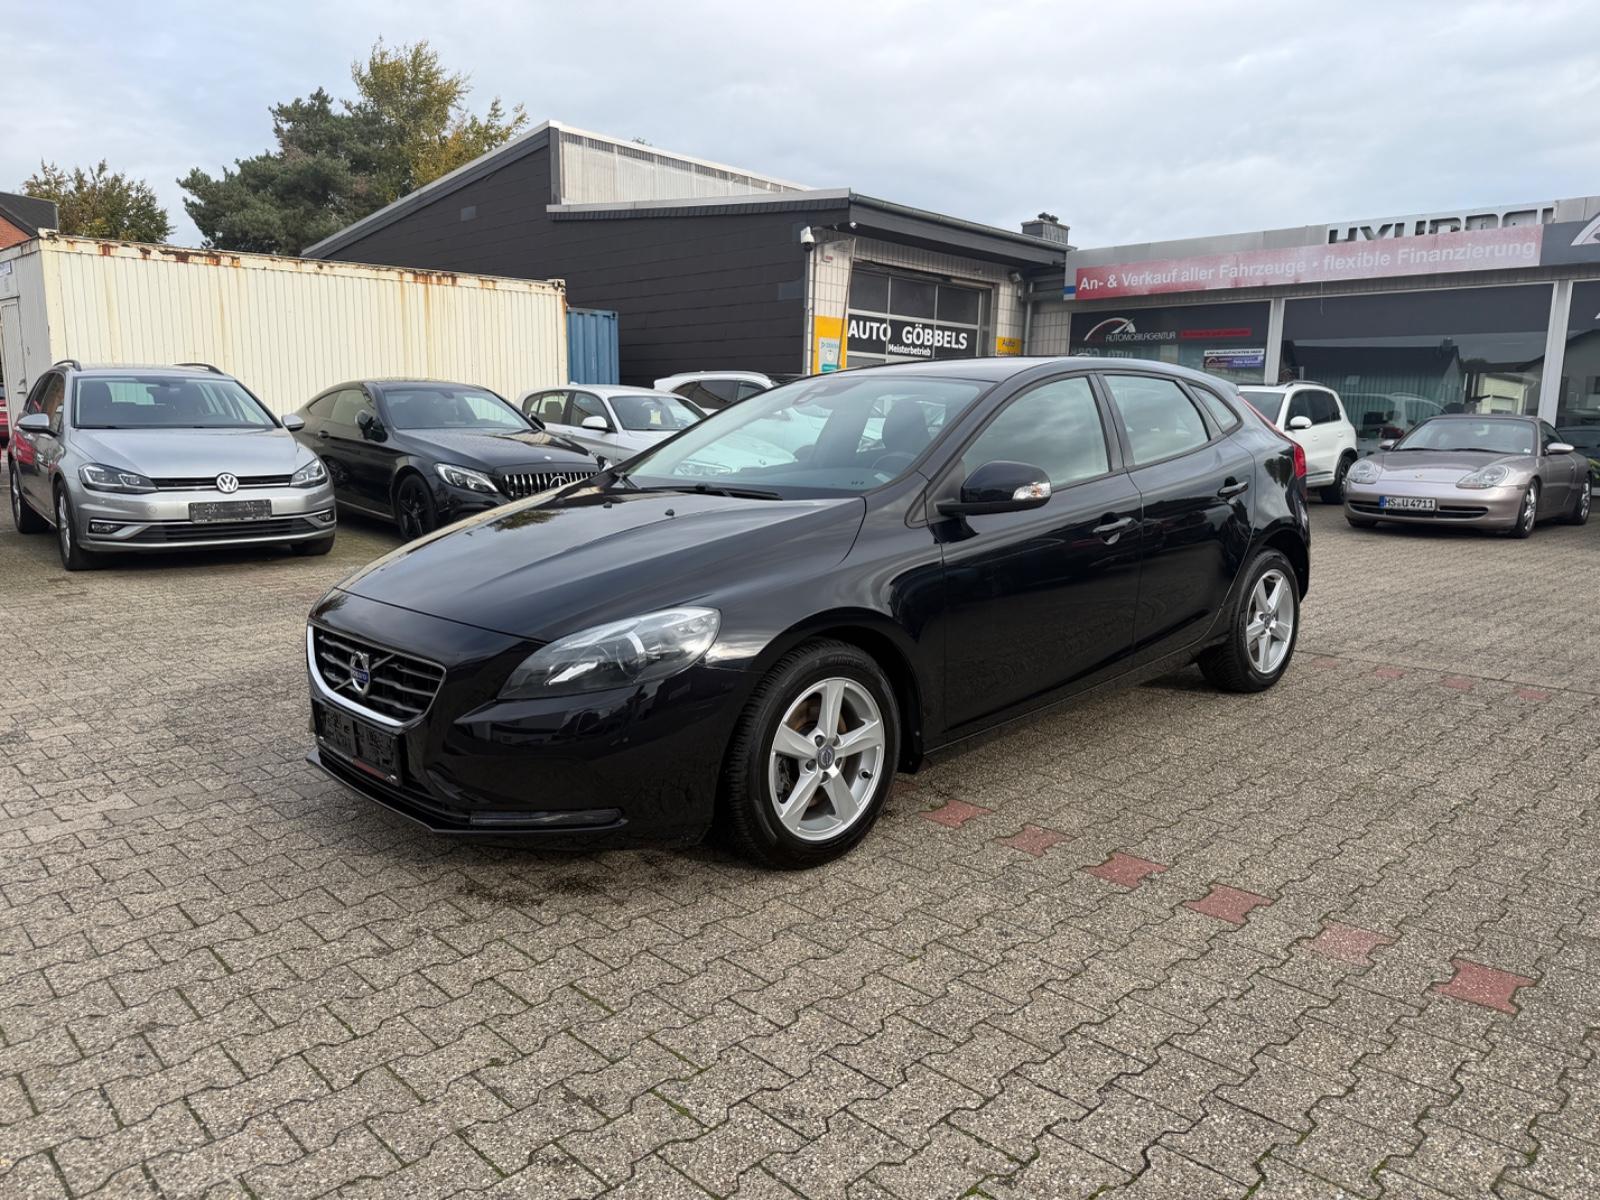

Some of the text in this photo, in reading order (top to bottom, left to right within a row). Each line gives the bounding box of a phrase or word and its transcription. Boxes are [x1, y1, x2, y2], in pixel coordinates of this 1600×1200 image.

[1079, 239, 1537, 291] An- & Verkauf aller Fahrzeuge flexible Finanzierung
[848, 319, 968, 350] AUTO GÖBBELS
[1105, 331, 1176, 343] AUTOMOBILAGENTUR
[888, 343, 932, 356] Meisterbetrieb
